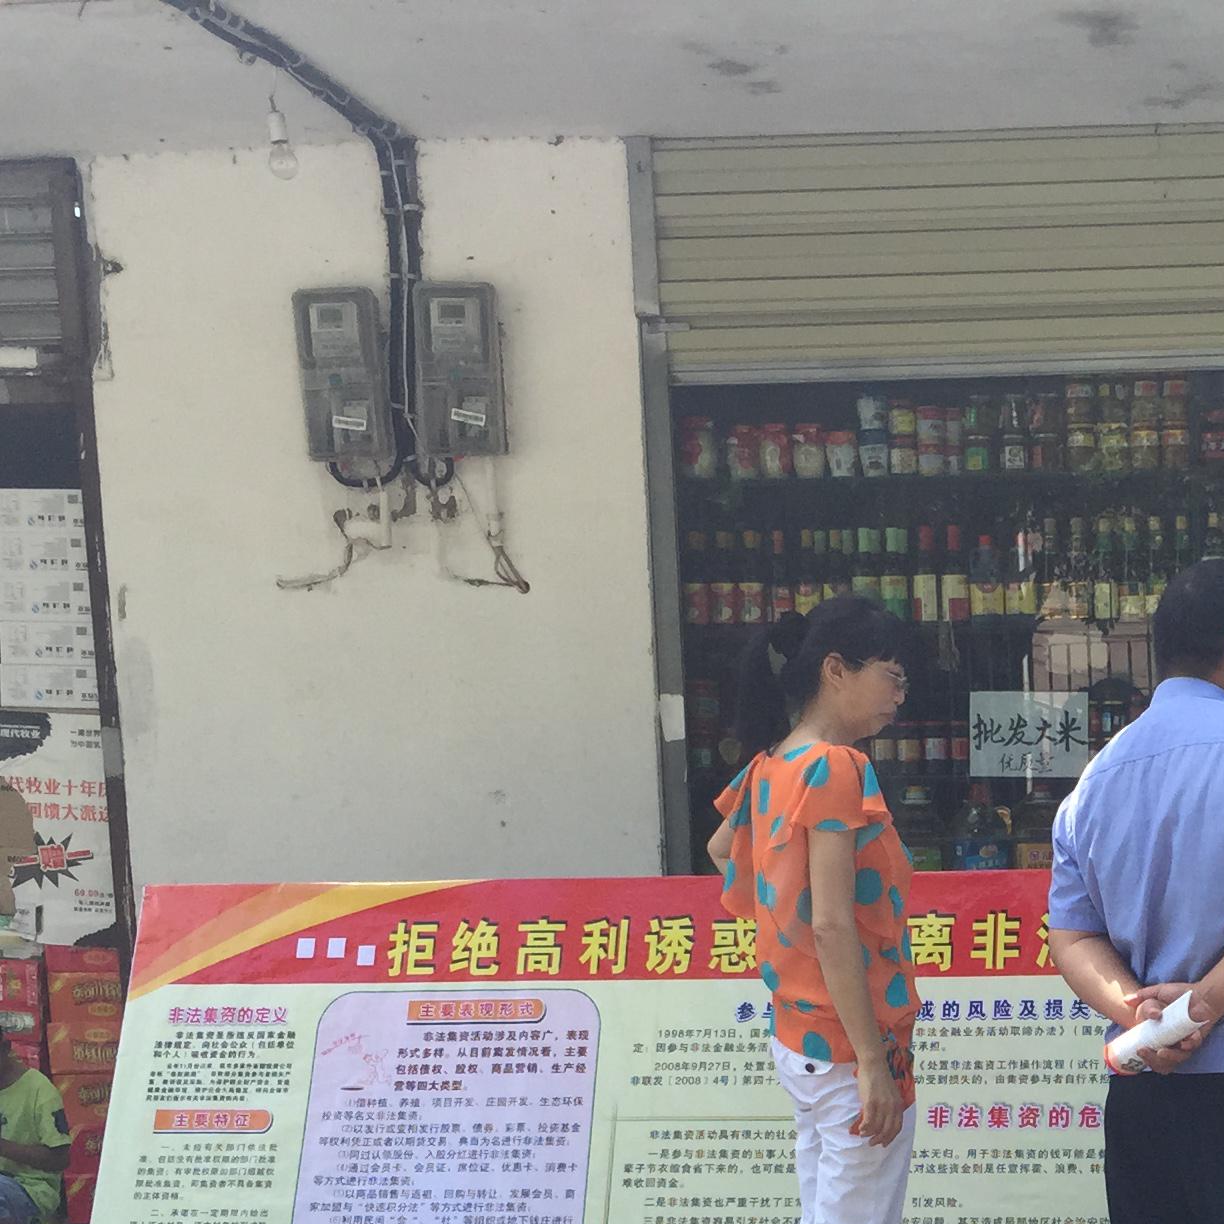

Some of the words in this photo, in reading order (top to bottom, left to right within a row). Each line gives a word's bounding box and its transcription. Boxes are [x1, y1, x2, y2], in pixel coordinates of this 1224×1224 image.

[973, 711, 1089, 752] 批发大米
[387, 916, 757, 974] 拒绝高利诱惑
[906, 913, 1055, 971] 离非
[169, 1007, 287, 1025] 非法集资的定义
[419, 1004, 536, 1018] 主要表现形式
[916, 1000, 1108, 1020] 成的风险及损失
[174, 1114, 250, 1126] 主要特征
[927, 1106, 1102, 1129] 非法集资的危
[909, 1163, 1105, 1175] 对这些资金则是任意挥霍、浪费、转
